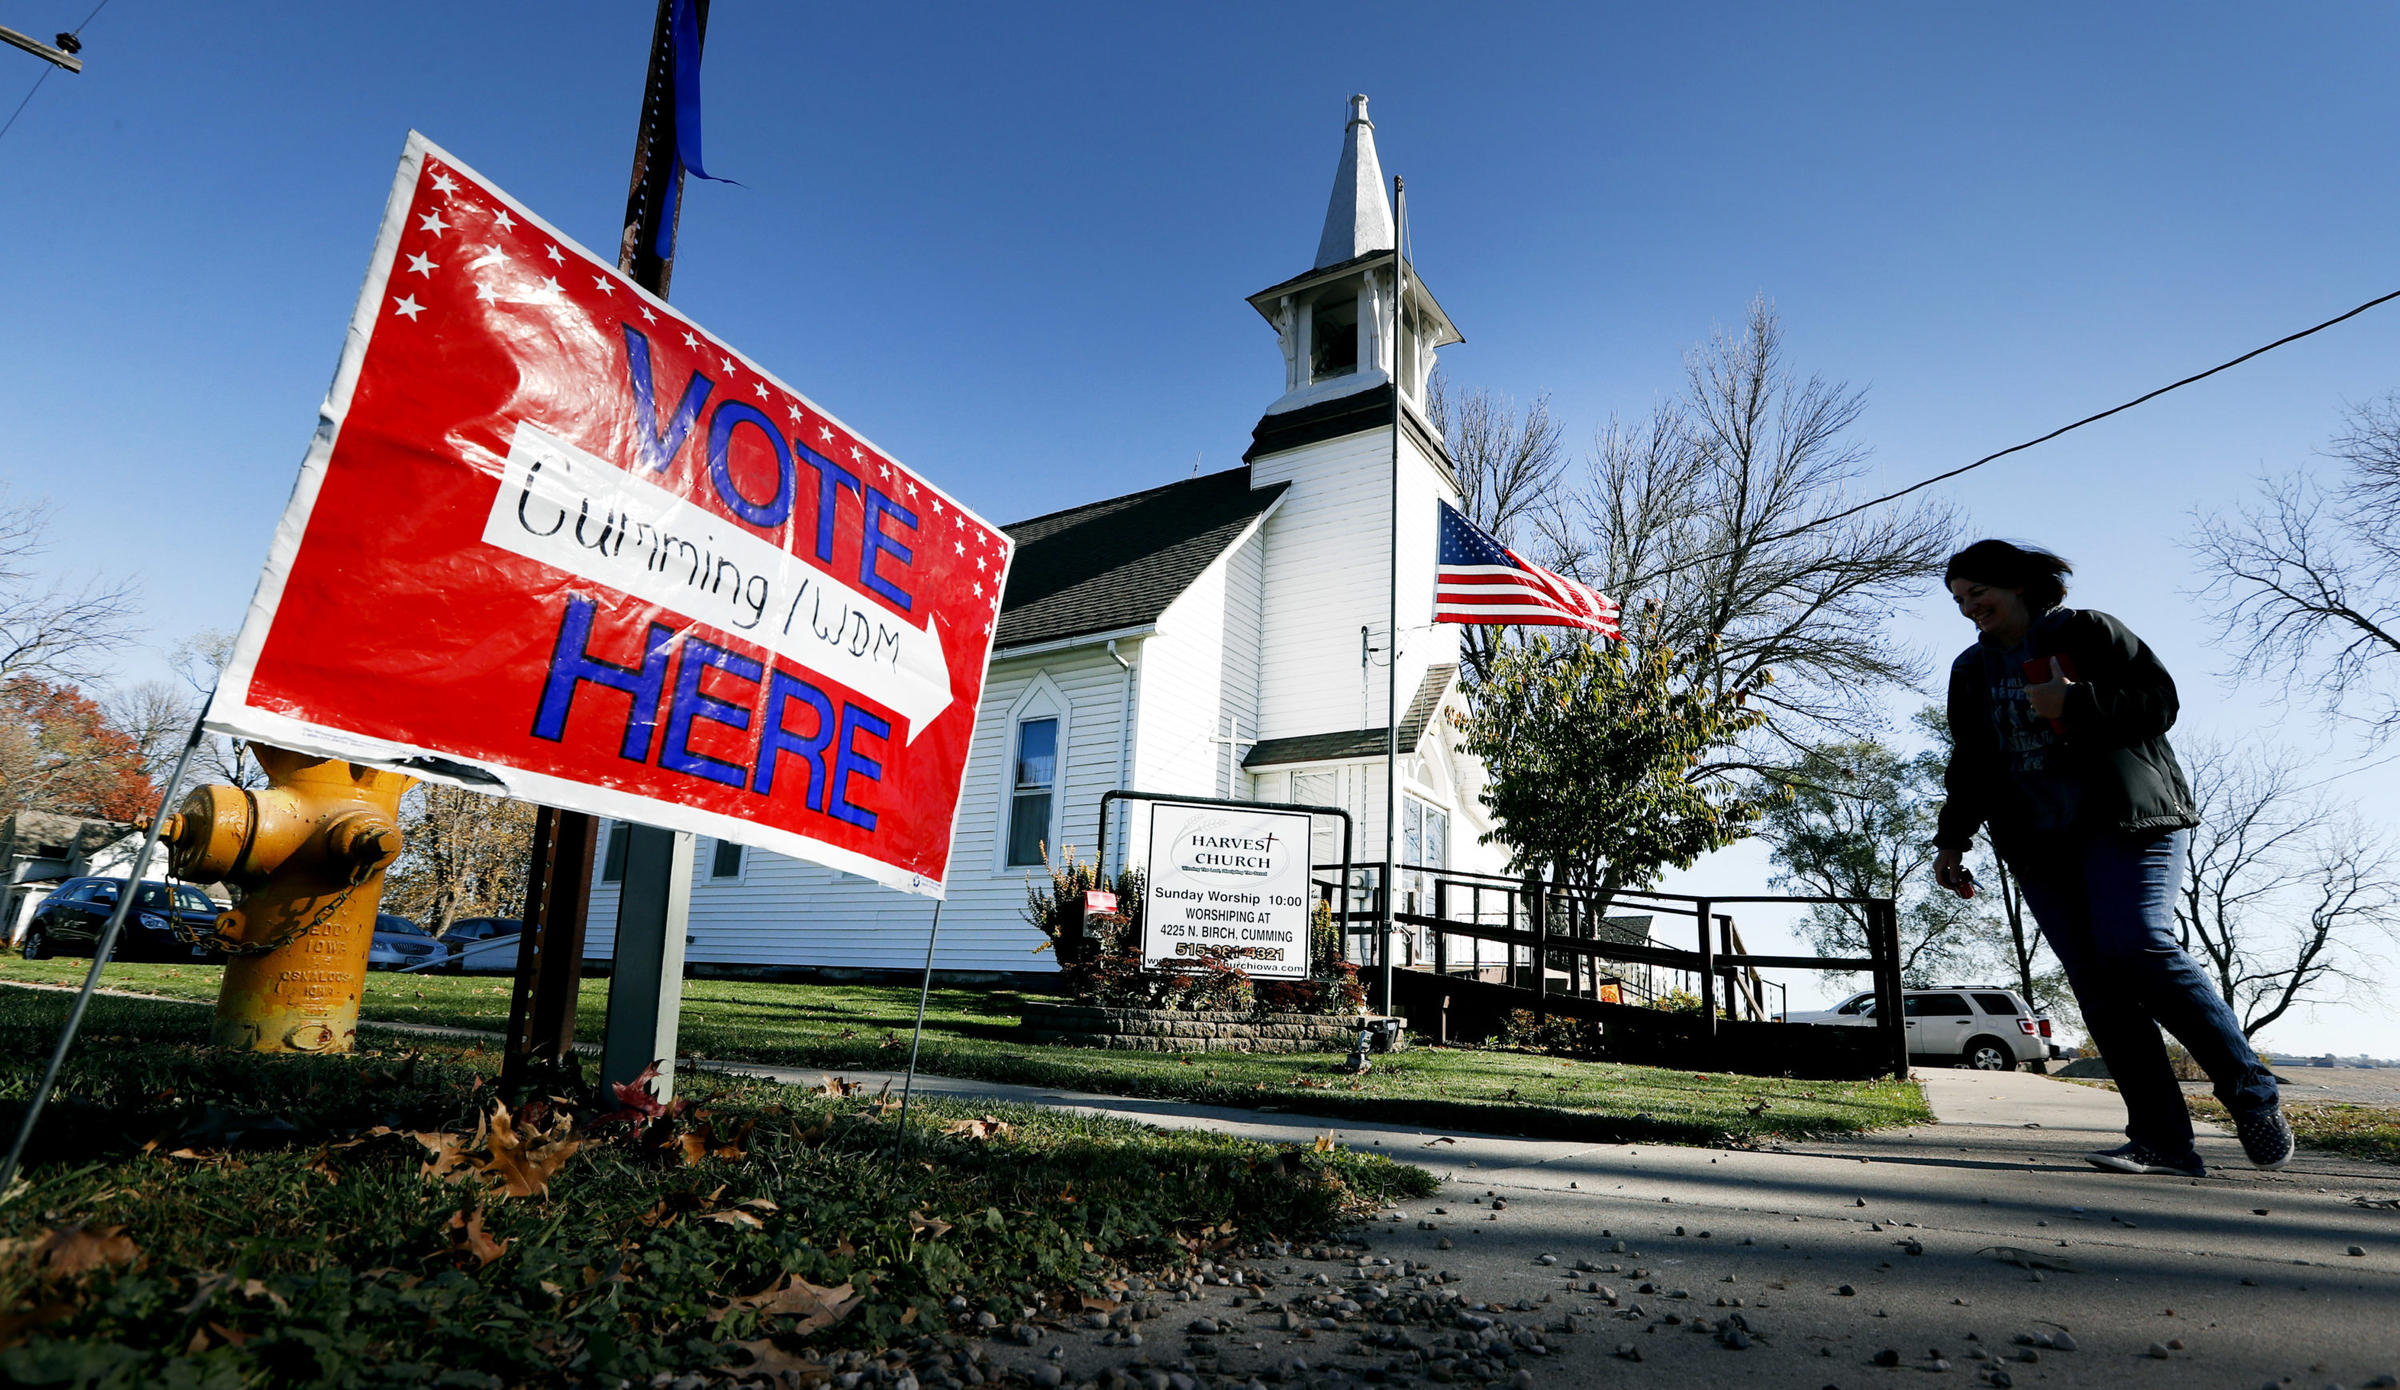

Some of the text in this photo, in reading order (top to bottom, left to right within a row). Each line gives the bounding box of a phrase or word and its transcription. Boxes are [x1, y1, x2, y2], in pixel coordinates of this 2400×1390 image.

[622, 322, 918, 612] VOTE
[530, 592, 890, 832] HERE
[1192, 832, 1279, 853] HARVEST
[1195, 853, 1270, 868] CHURCH
[1155, 887, 1302, 906] Sunday Worship 10:00
[1186, 908, 1271, 924] WORSHIPING AT
[1160, 924, 1184, 936] 4225
[1188, 926, 1198, 937] N.
[1241, 928, 1293, 942] CUMMING
